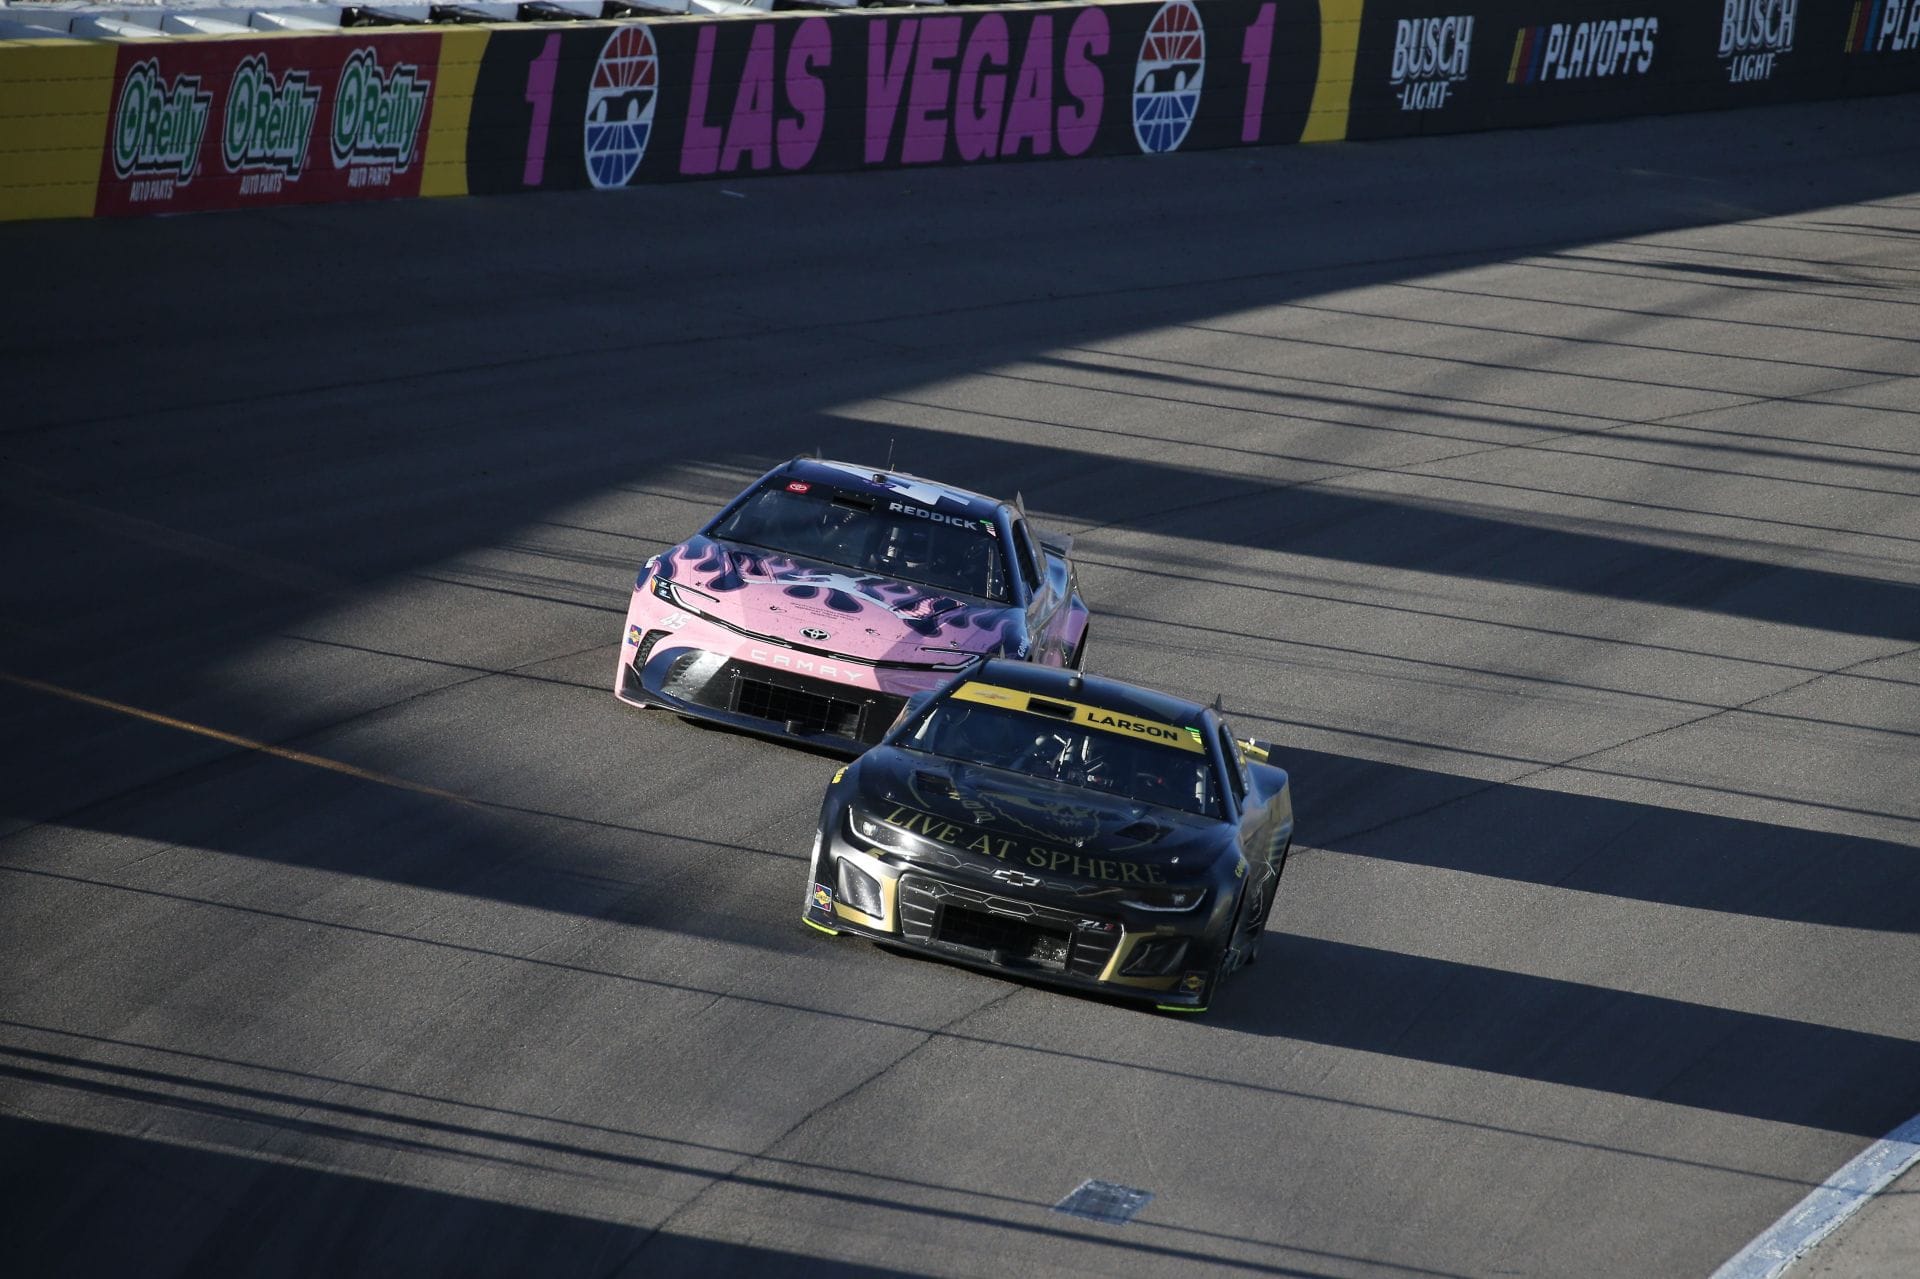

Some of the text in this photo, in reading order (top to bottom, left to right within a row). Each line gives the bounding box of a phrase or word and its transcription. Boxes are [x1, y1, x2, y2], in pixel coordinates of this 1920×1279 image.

[1391, 15, 1475, 82] BUSCH
[1717, 0, 1799, 54] BUSCH
[1540, 17, 1658, 81] PLAYOFFS
[1730, 53, 1776, 82] LIGHT
[334, 54, 427, 168] O'Reilly
[523, 3, 1277, 186] 1 LAS VEGAS 1
[1400, 82, 1450, 110] LIGHT
[116, 66, 209, 181] O'Reilly
[225, 61, 317, 176] O'Reilly
[129, 179, 175, 202] AUTO PARTS
[239, 173, 282, 195] AUTO PARTS
[348, 166, 391, 187] AUTO PARTS
[889, 502, 978, 531] REDDICK
[751, 649, 864, 681] CAMRY
[1087, 712, 1179, 741] LARSON
[885, 806, 1168, 885] LIVE AT SPHERE
